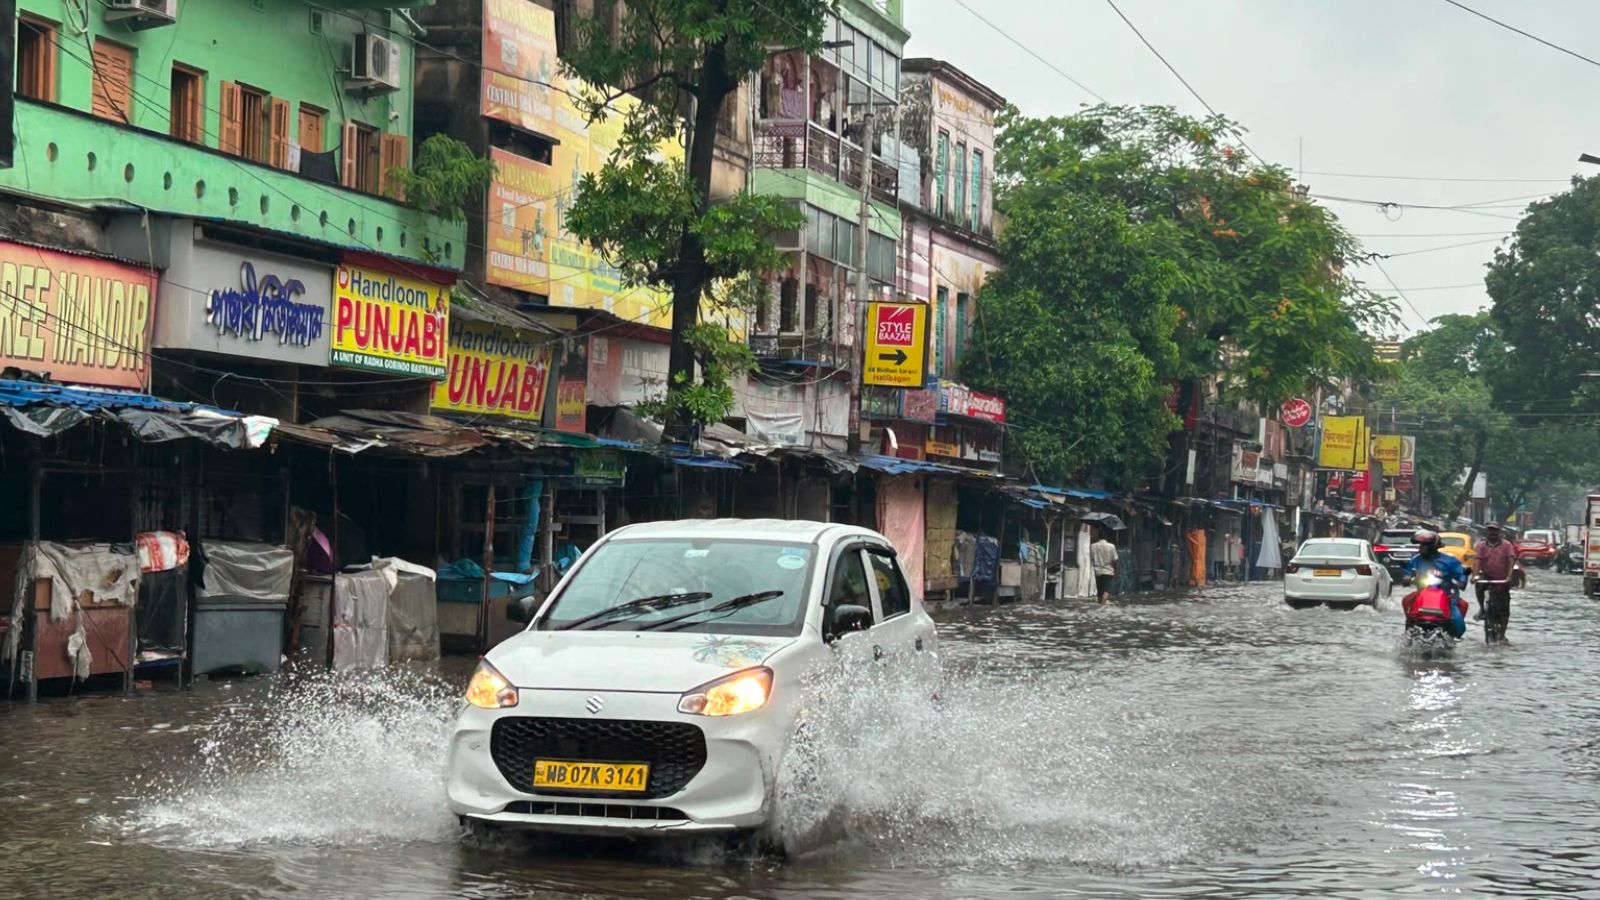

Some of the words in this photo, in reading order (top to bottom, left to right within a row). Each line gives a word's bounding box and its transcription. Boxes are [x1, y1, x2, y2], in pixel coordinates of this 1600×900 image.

[350, 269, 428, 309] Handloom
[53, 270, 149, 371] MANDIR
[337, 297, 446, 360] PUNJABI
[451, 320, 536, 361] Handloom
[879, 332, 911, 341] BAAZAR
[880, 322, 911, 333] STYLE
[333, 352, 338, 361] A
[339, 353, 354, 363] UNIT
[354, 355, 362, 364] OF
[363, 356, 384, 368] RADHA
[431, 354, 547, 413] UNJABI
[546, 765, 567, 783] WB
[570, 766, 600, 785] 07K
[603, 767, 643, 786] 3141
